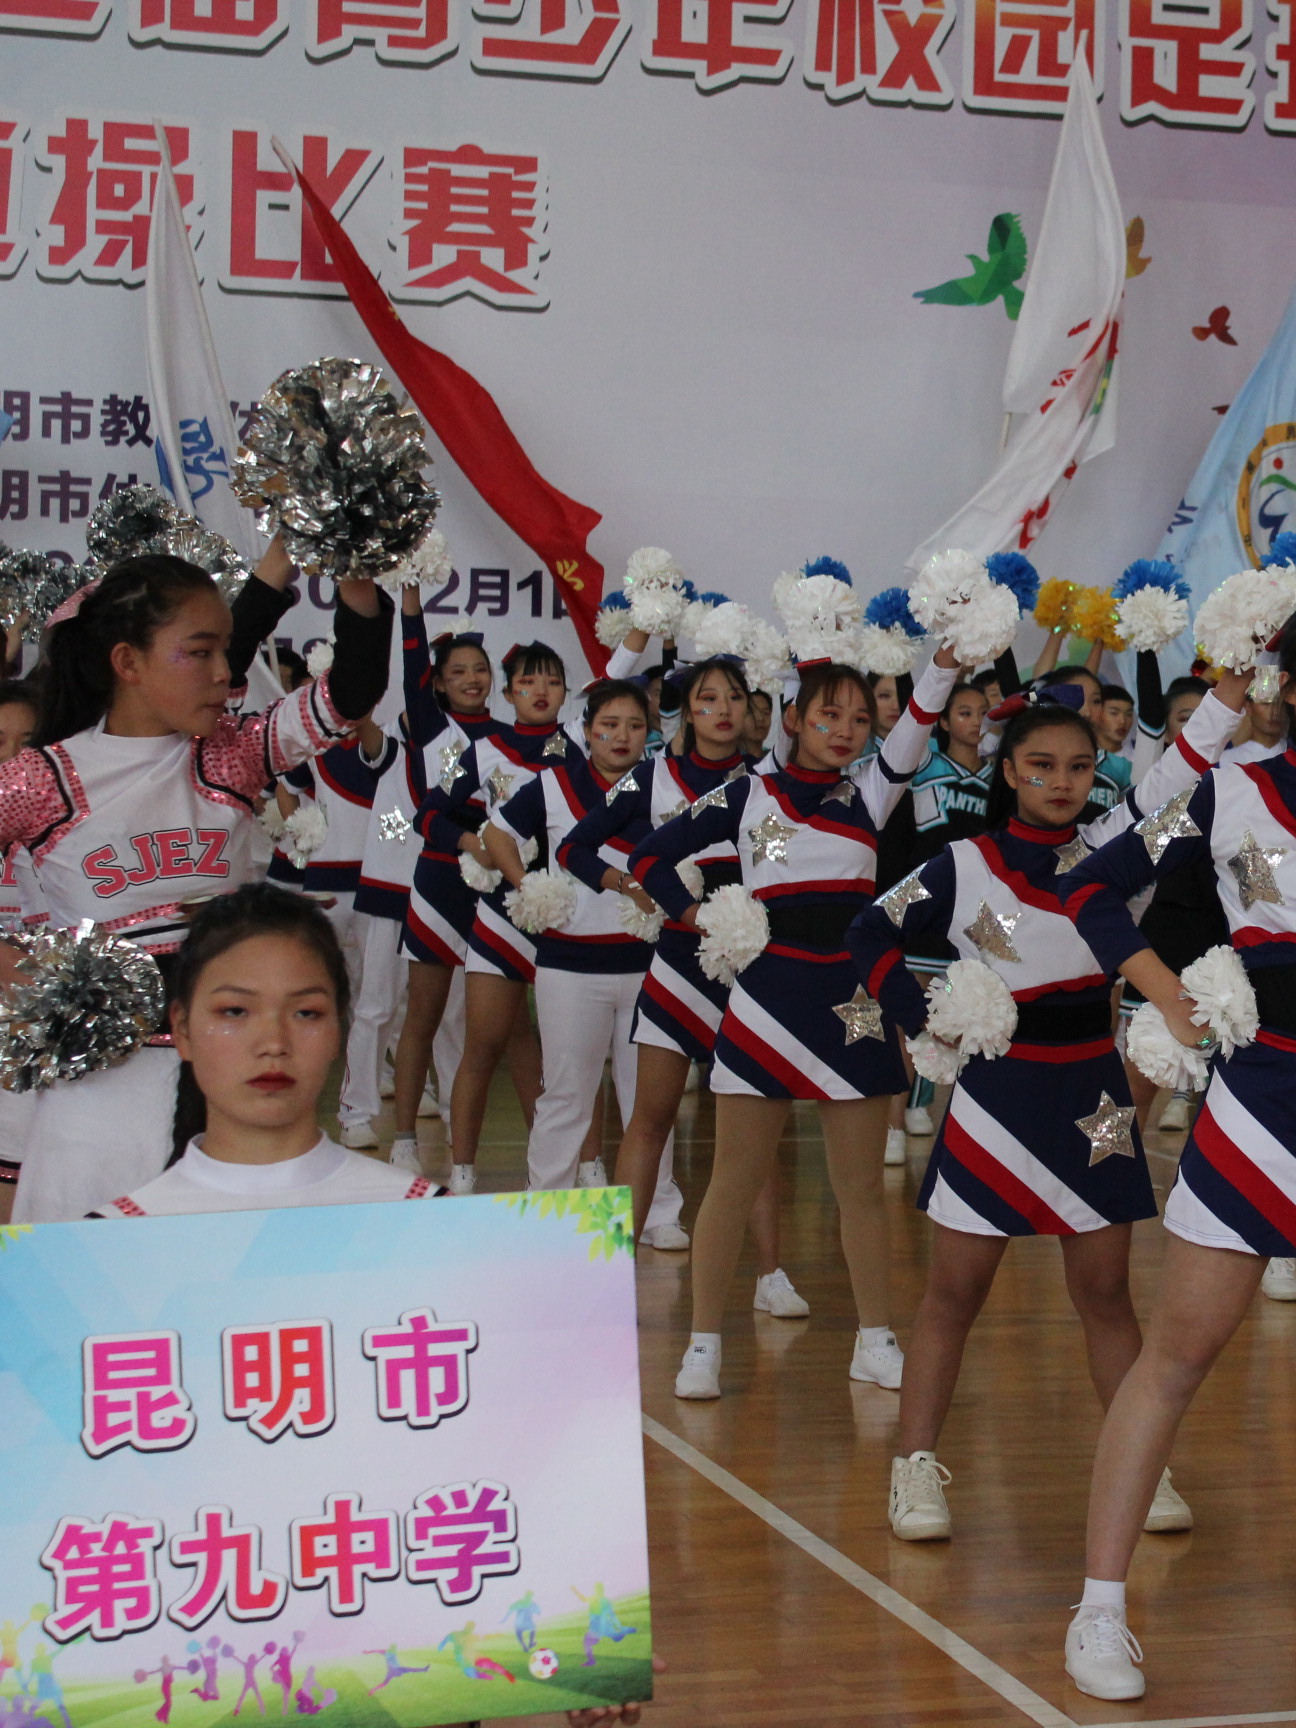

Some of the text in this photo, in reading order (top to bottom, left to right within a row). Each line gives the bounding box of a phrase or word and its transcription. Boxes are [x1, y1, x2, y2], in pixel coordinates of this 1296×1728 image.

[0, 117, 540, 297] 操比赛
[82, 828, 230, 898] SJEZ
[83, 1310, 475, 1454] 昆明市
[44, 1482, 517, 1639] 第九中学
